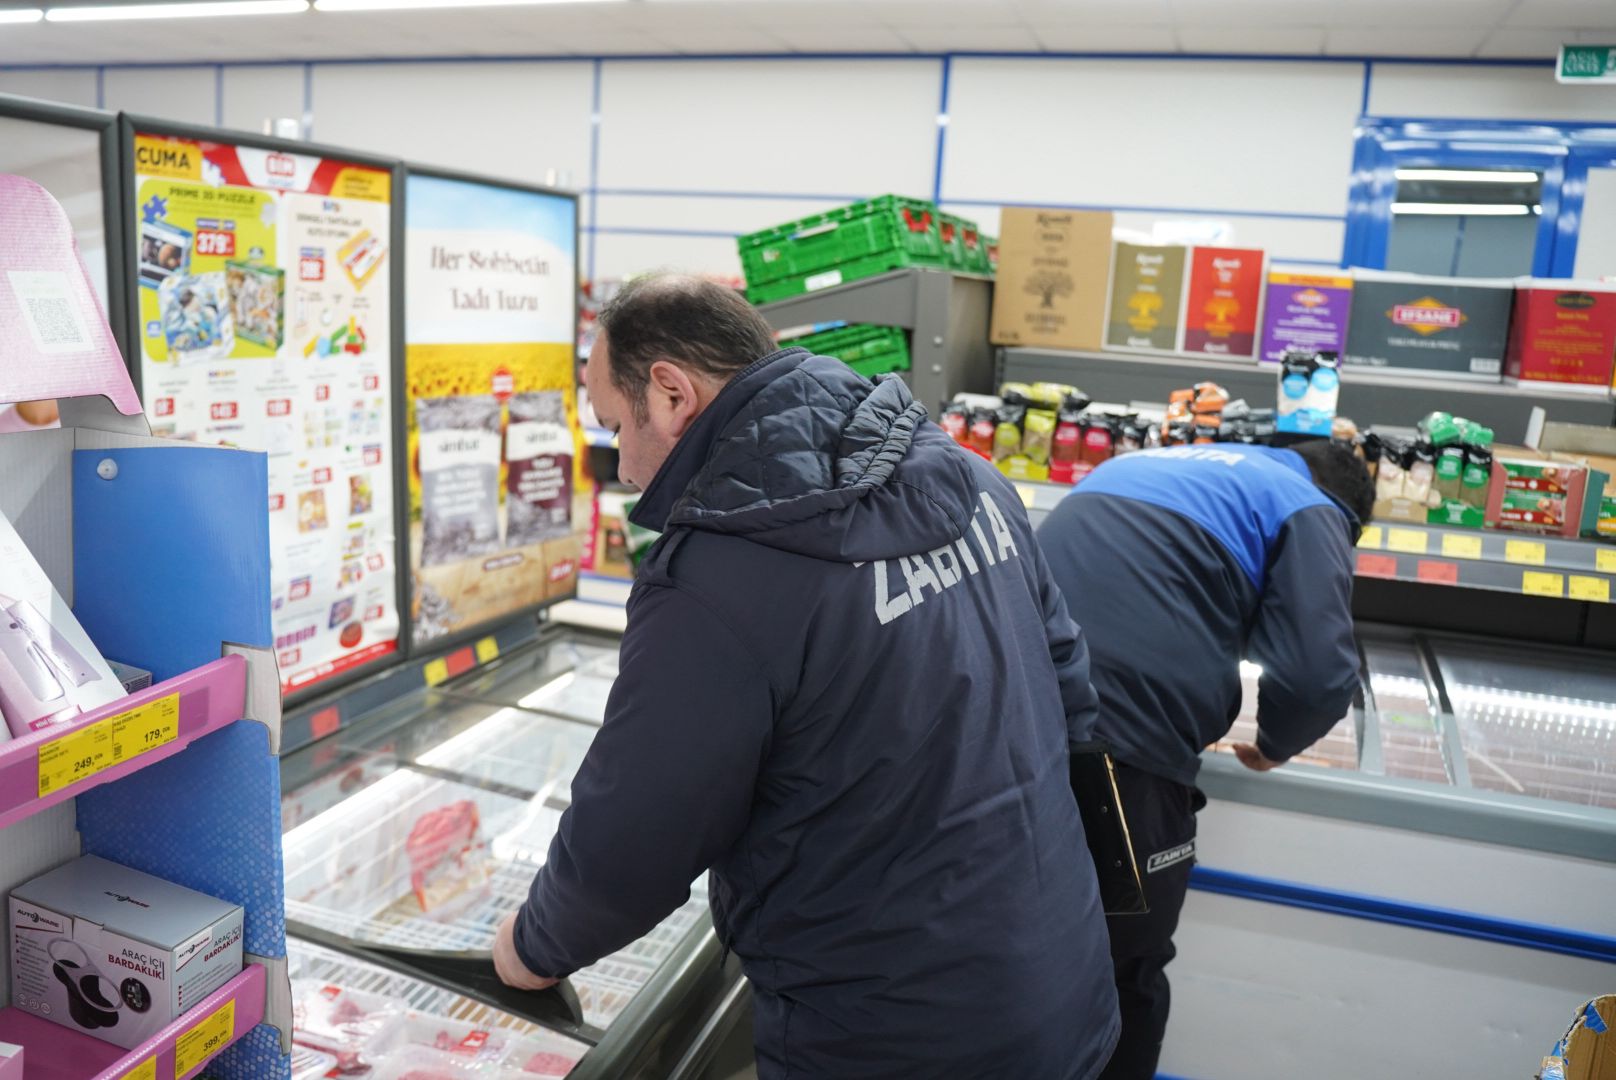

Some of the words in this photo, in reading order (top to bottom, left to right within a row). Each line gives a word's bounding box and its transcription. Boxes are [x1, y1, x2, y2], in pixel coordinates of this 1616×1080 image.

[137, 147, 191, 169] CUMA
[108, 953, 162, 980] BARDAKLIK
[121, 948, 147, 966] ARAÇ
